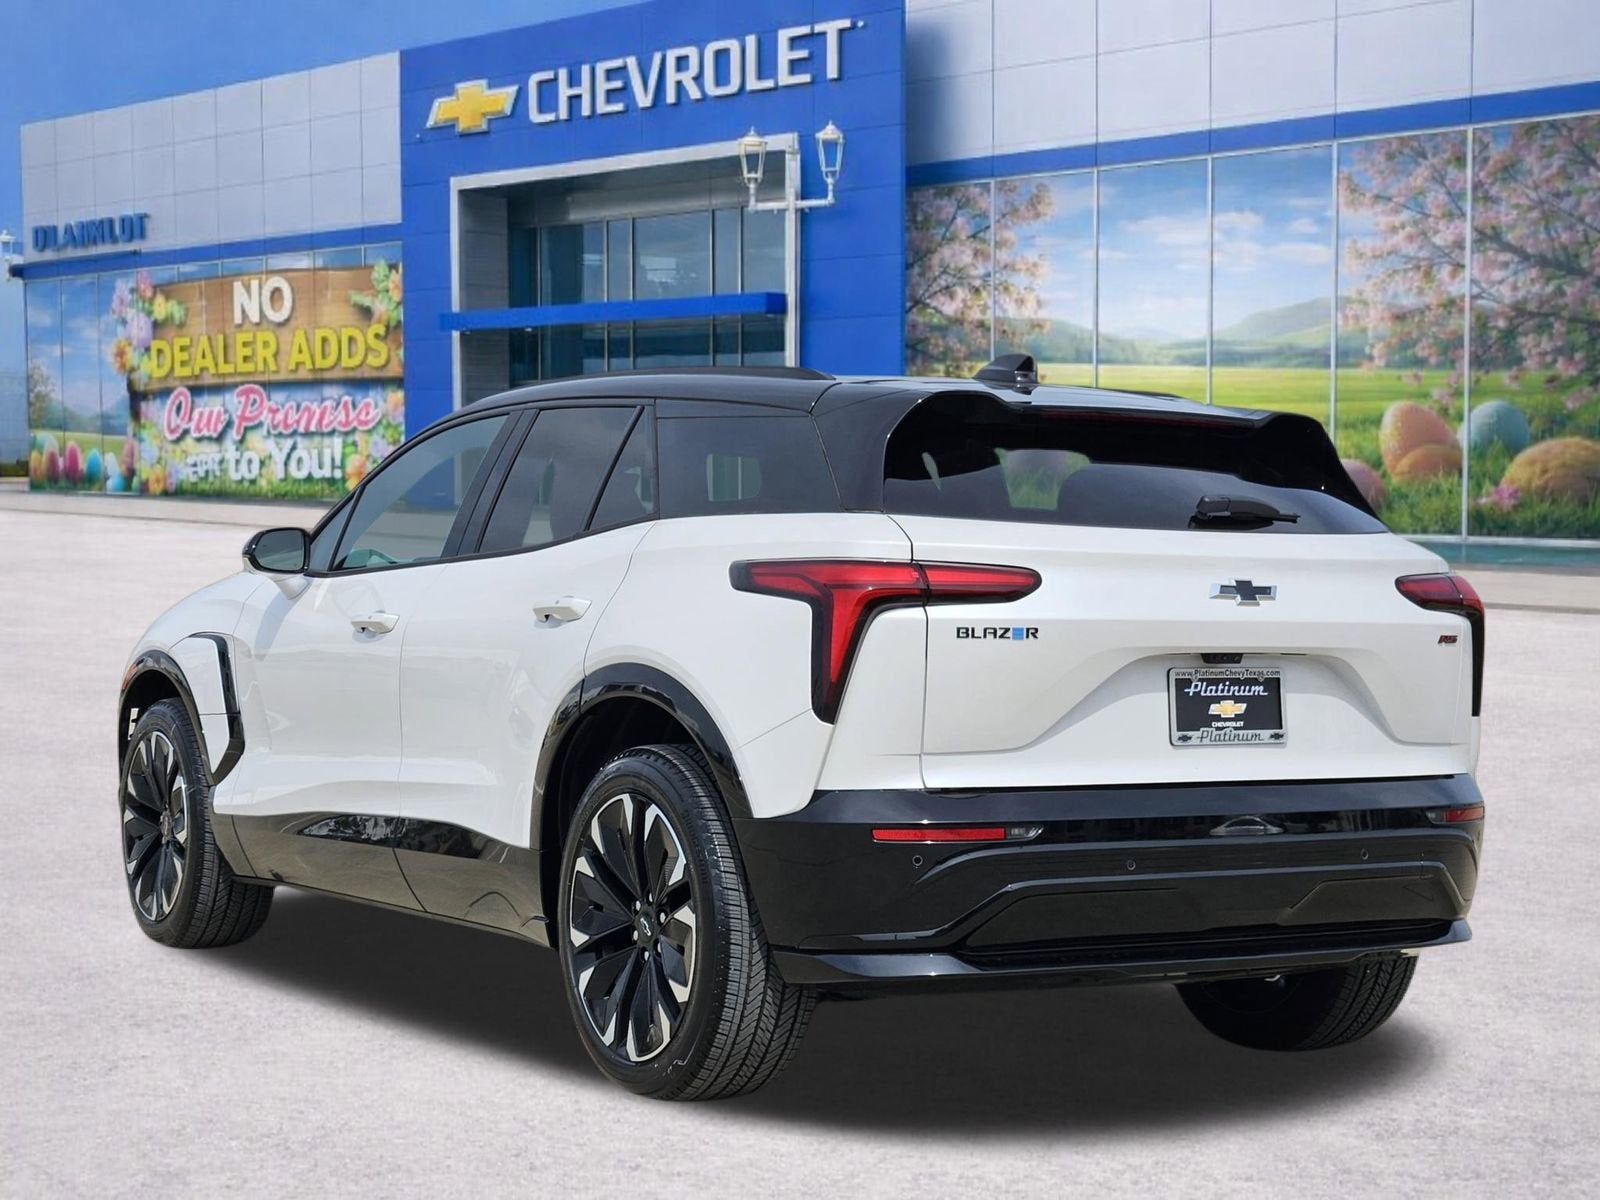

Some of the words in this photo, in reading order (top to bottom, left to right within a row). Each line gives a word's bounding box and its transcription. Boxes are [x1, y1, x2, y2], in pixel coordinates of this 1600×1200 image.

[528, 18, 852, 124] CHEVROLET
[233, 276, 293, 325] NO
[150, 330, 278, 378] DEALER
[288, 324, 390, 371] ADDS
[165, 387, 229, 440] Our
[225, 444, 260, 480] to
[267, 437, 342, 480] You!
[956, 627, 1039, 640] BLAZER
[1175, 669, 1281, 678] www.PlatinumChevyTexas.com
[1184, 681, 1268, 696] Platinum
[1196, 728, 1264, 743] Platinum
